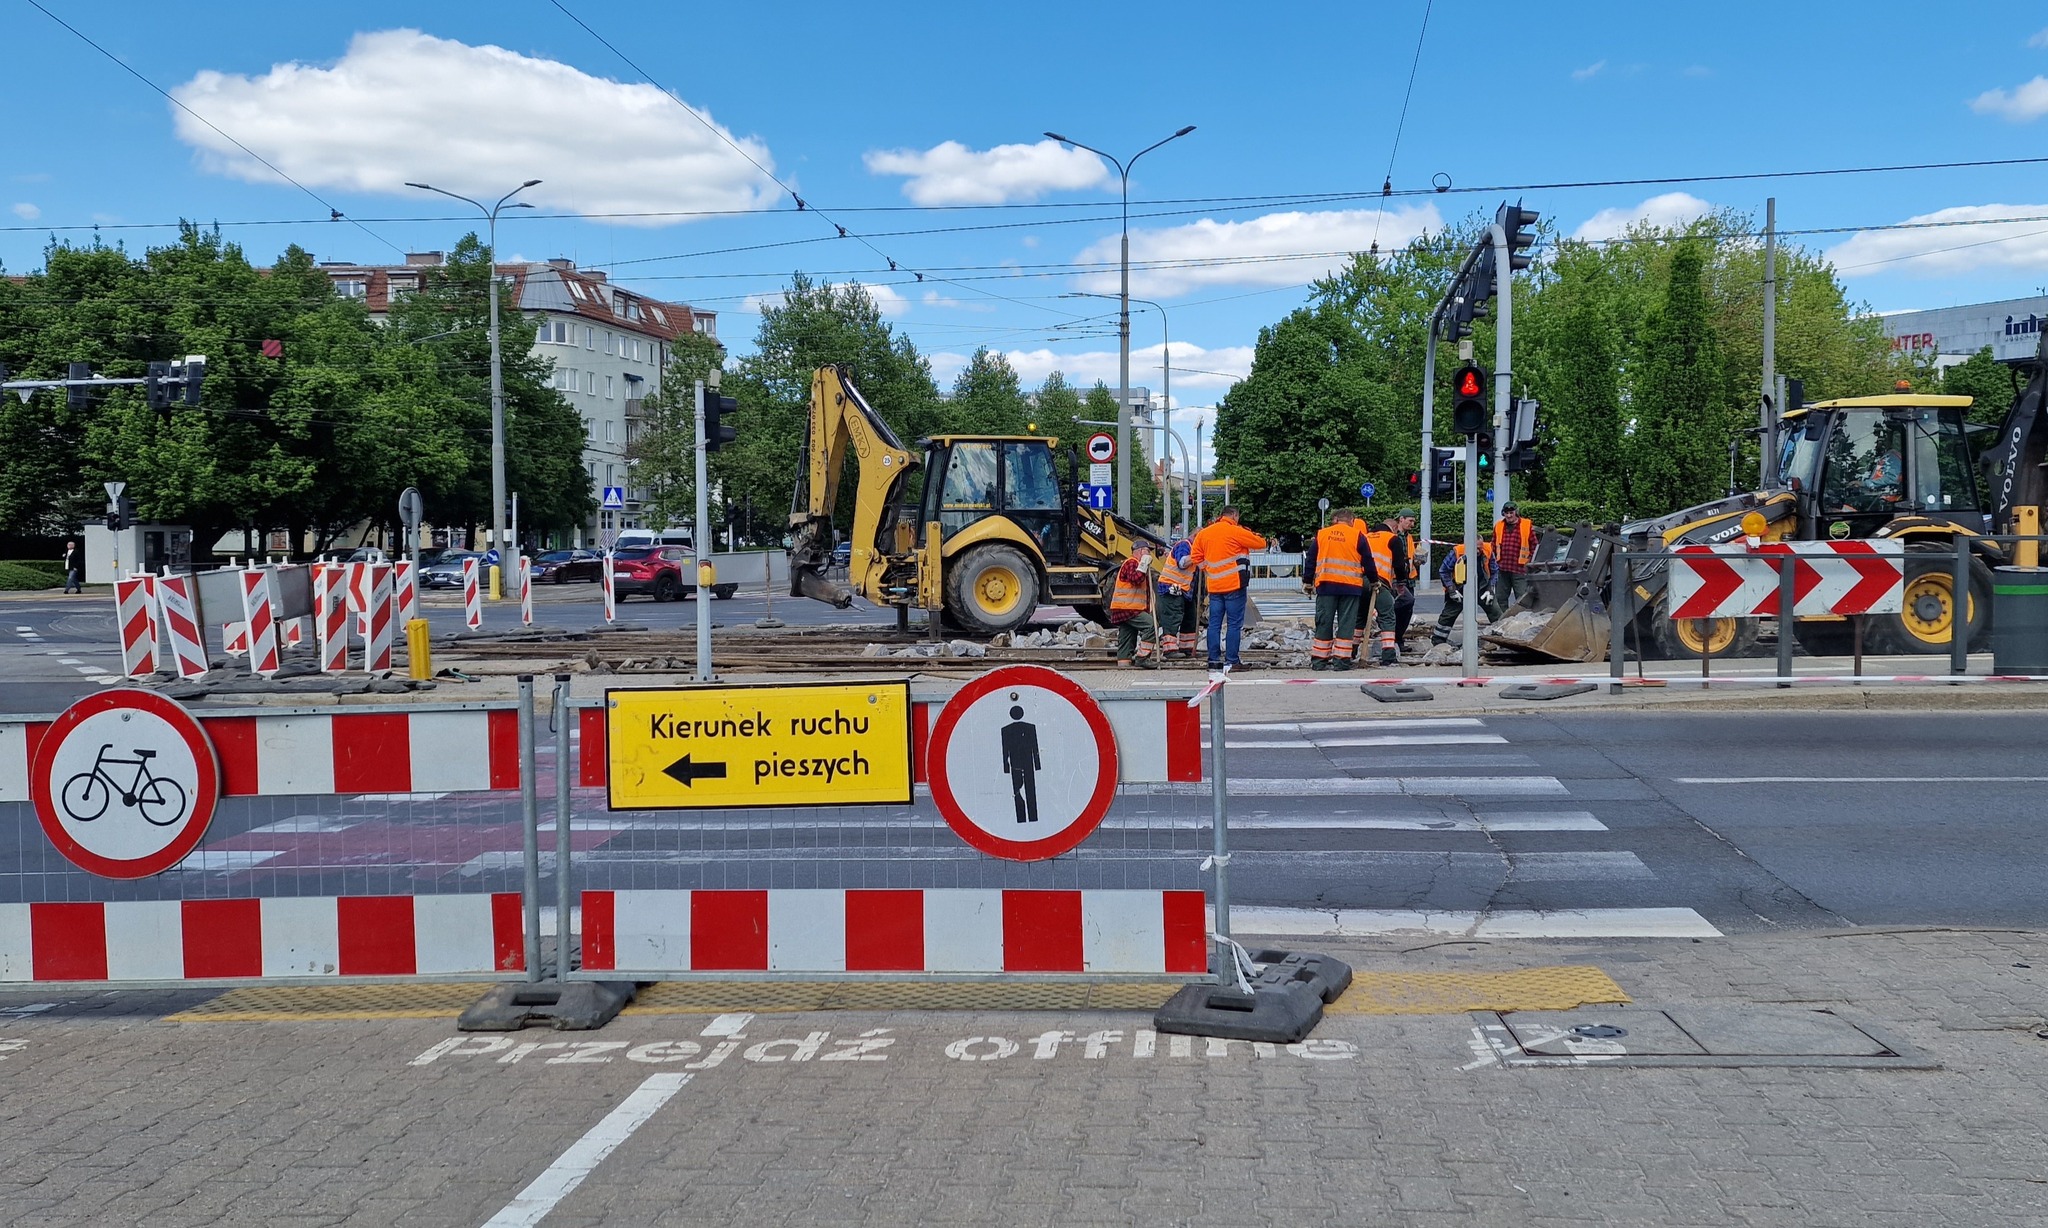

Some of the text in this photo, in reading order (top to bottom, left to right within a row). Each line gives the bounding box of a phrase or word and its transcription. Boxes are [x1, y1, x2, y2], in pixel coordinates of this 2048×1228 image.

[851, 420, 868, 455] EMKA
[1999, 427, 2021, 513] VOLVO
[1710, 524, 1743, 542] VOLV
[651, 709, 869, 739] Kierunek ruchu
[754, 750, 869, 785] pieszych
[407, 1028, 1359, 1069] Przejdź offline
